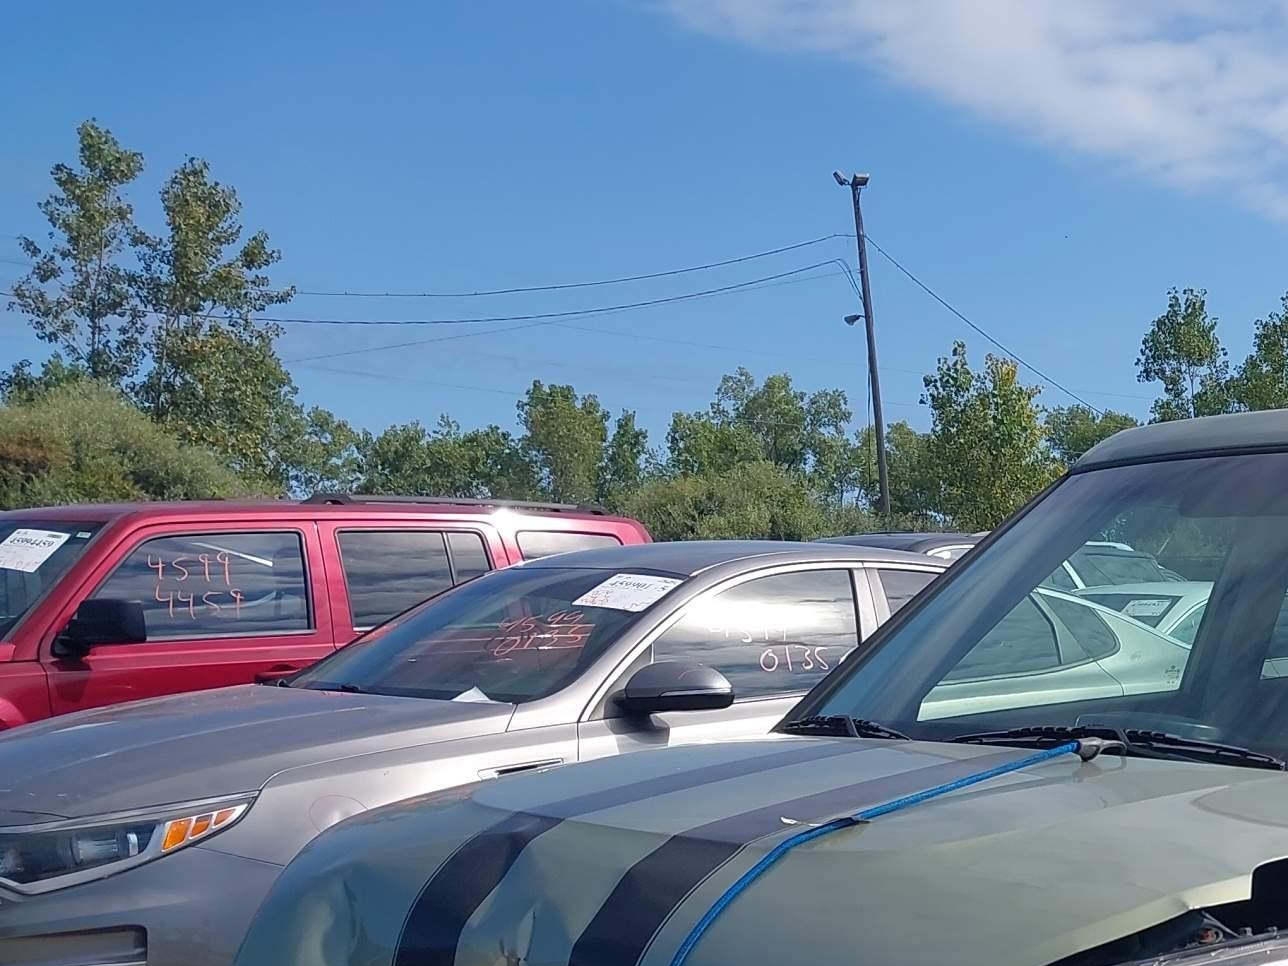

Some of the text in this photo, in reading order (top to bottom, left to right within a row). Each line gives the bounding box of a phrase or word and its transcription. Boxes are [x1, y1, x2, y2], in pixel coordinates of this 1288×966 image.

[147, 551, 232, 586] 4599
[155, 585, 246, 620] 4459
[759, 645, 830, 673] 0135
